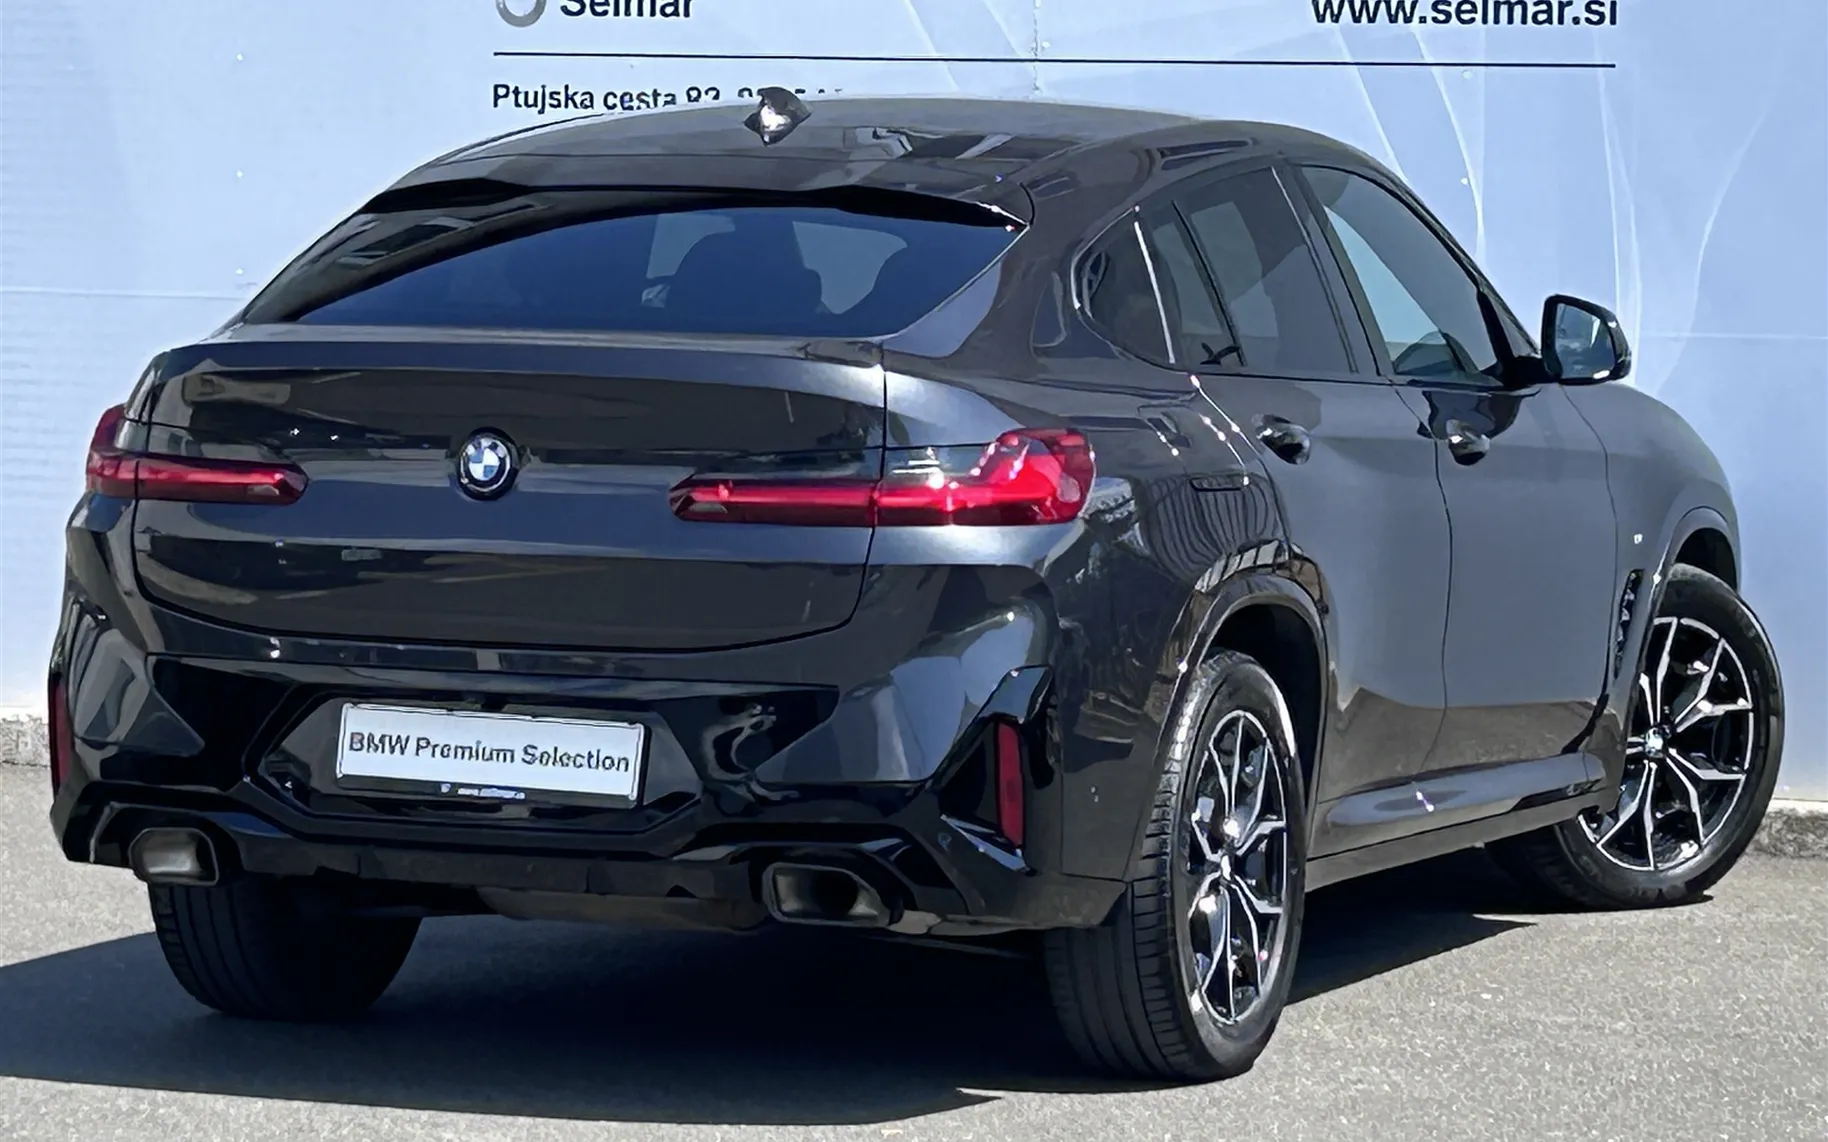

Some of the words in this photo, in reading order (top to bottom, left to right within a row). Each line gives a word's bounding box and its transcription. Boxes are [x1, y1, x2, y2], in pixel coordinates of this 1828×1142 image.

[1311, 0, 1617, 25] www.selmar.si
[493, 84, 594, 115] Ptujska
[603, 88, 677, 111] cesta
[349, 732, 410, 756] BMW
[415, 737, 515, 763] Premium
[521, 744, 630, 772] Selection
